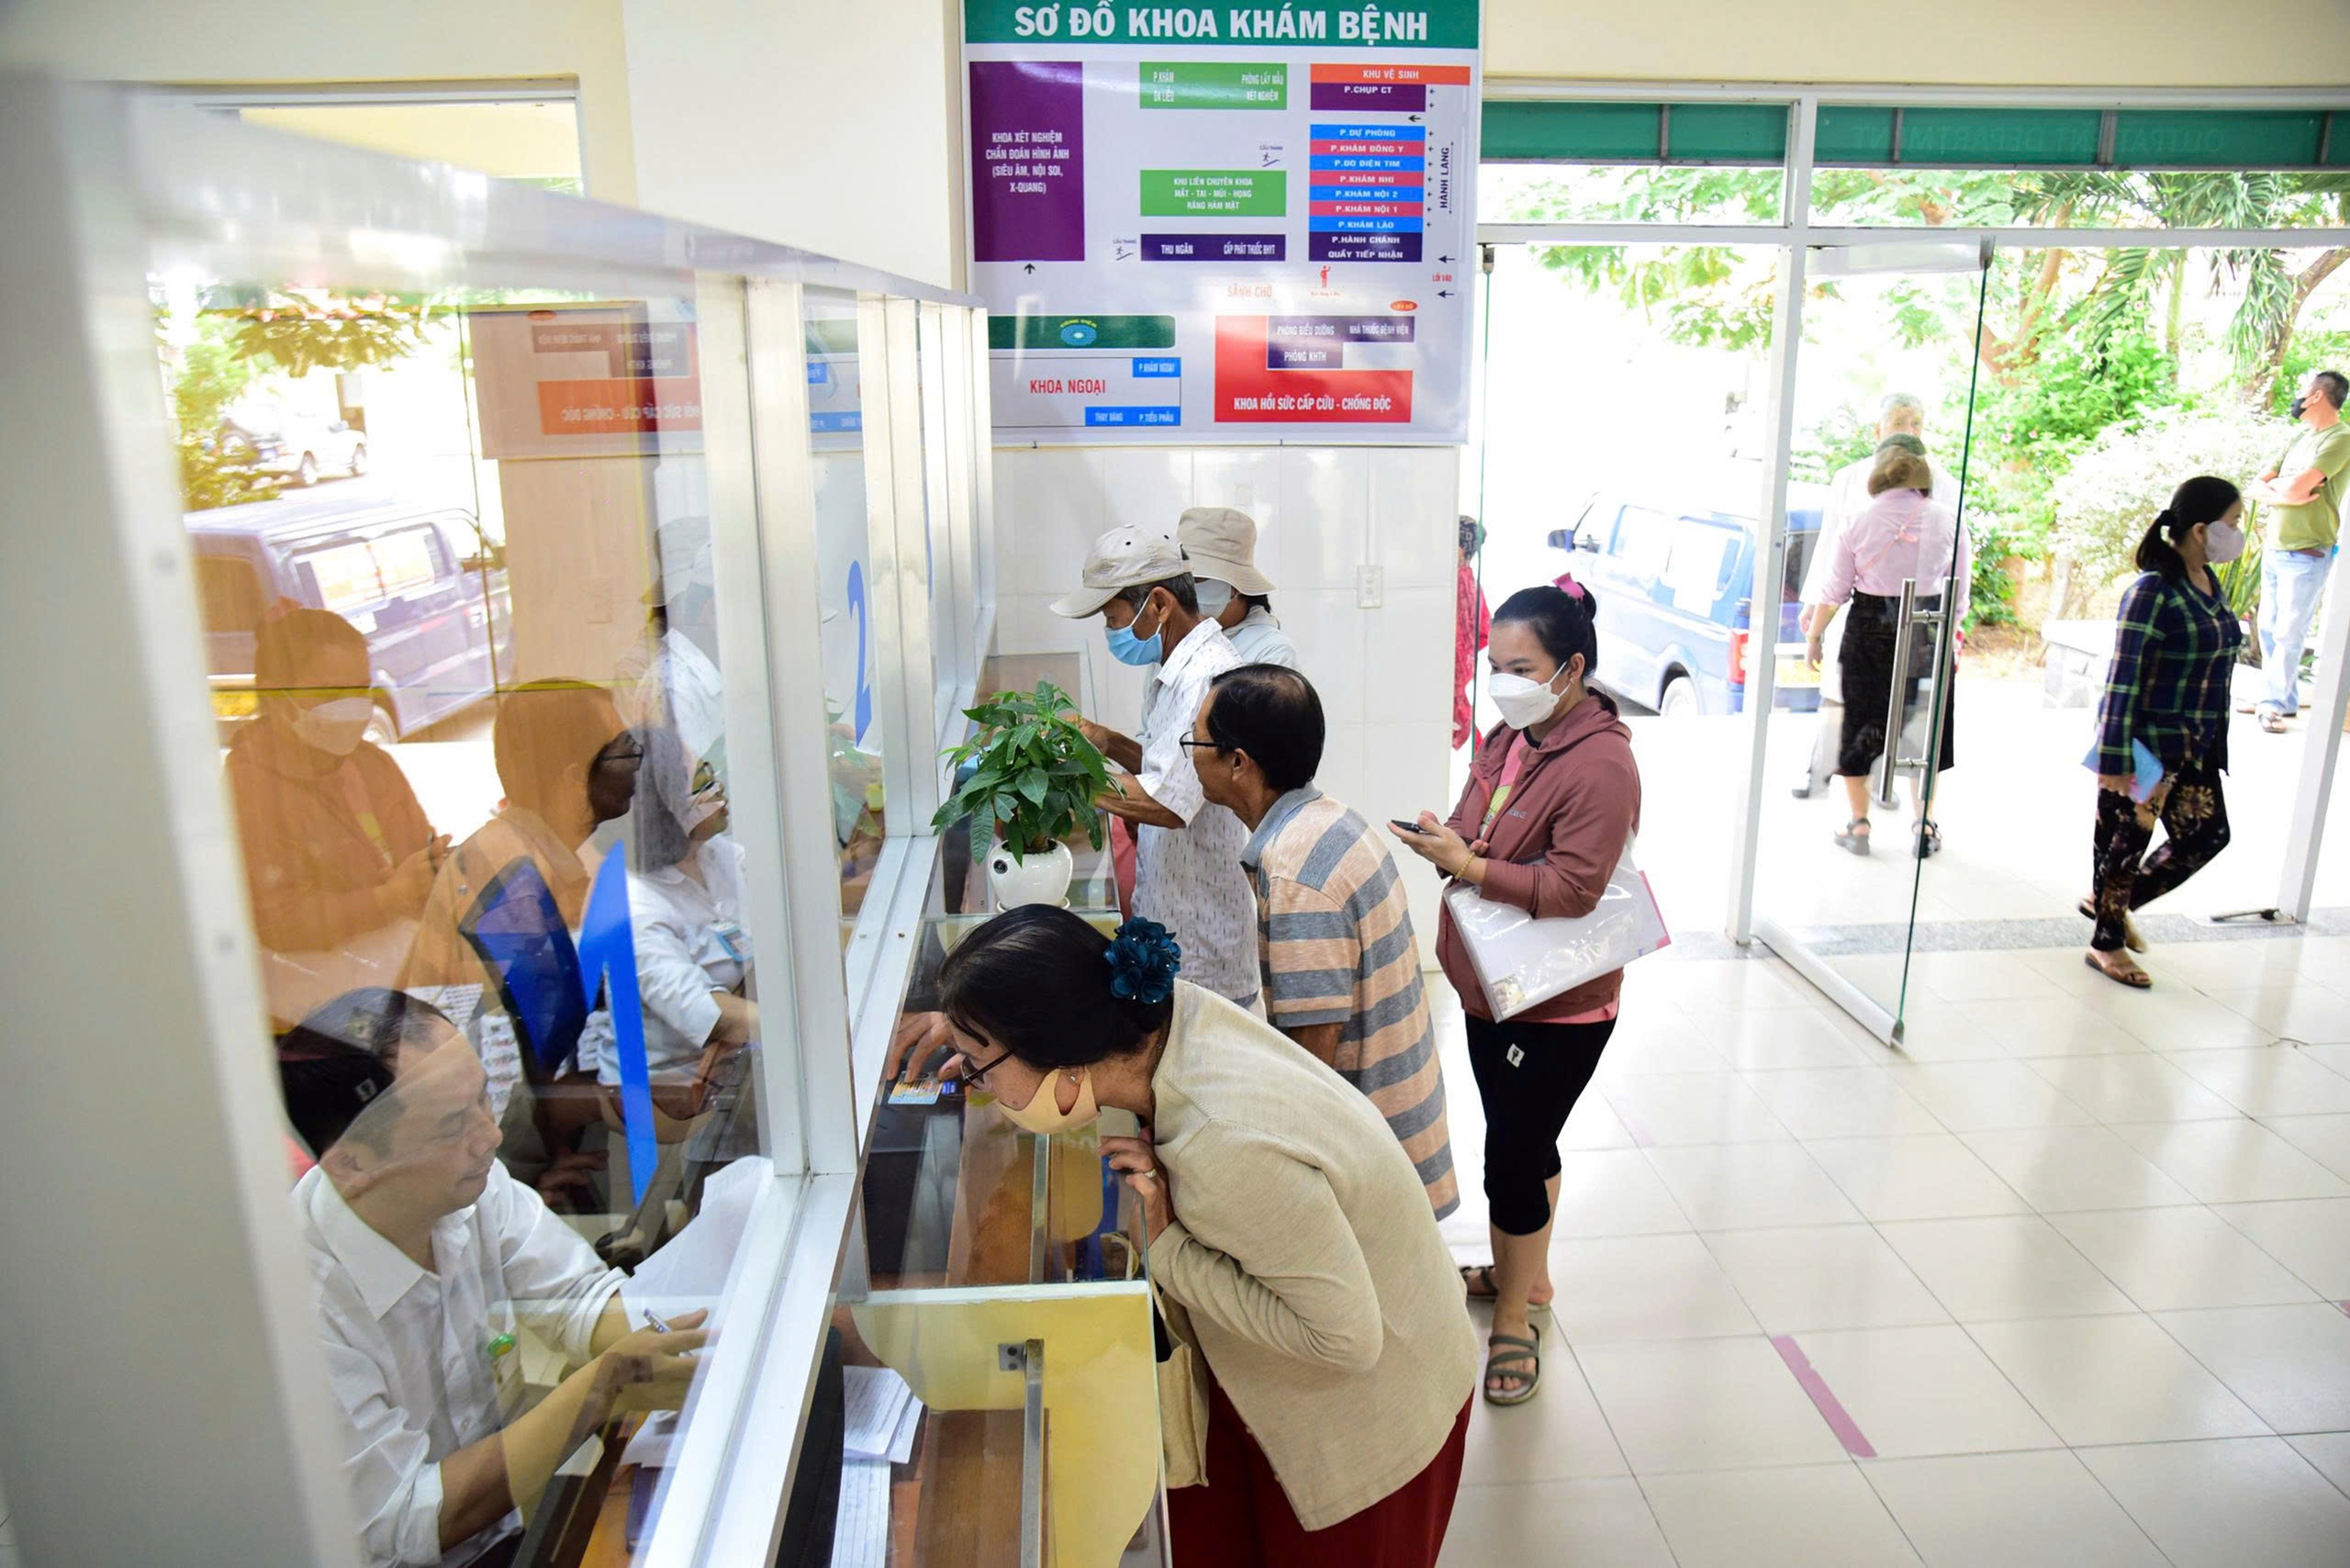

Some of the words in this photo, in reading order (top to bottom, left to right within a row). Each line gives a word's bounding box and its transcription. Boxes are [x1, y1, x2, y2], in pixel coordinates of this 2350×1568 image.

[1014, 3, 1060, 37] SƠ
[1069, 0, 1115, 38] ĐỒ
[1128, 8, 1218, 38] KHOA
[1229, 3, 1326, 39] KHÁM
[1338, 4, 1427, 46] BỆNH
[1362, 70, 1381, 79] KHU
[1383, 67, 1395, 81] VỆ
[1398, 70, 1419, 80] SINH
[992, 132, 1013, 142] KHOA
[1014, 129, 1029, 142] XÉT
[1031, 129, 1062, 144] NGHIỆM
[1365, 128, 1395, 137] PHÒNG
[985, 146, 1007, 160] CHẨN
[1009, 147, 1030, 160] ĐOÁN
[1032, 147, 1051, 160] HÌNH
[1053, 146, 1069, 160] ẢNH
[1384, 160, 1400, 168] TIM
[1440, 147, 1450, 176] LANG
[992, 163, 1013, 177] (SIÊU
[1032, 163, 1046, 179] NỘI
[1173, 177, 1187, 186] KHU
[1189, 175, 1204, 186] LIÊN
[1206, 175, 1233, 186] CHUYÊN
[1235, 177, 1253, 186] KHOA
[1010, 182, 1046, 194] X-QUANG)
[1196, 189, 1206, 197] TAI
[1233, 189, 1252, 199] HỌNG
[1373, 189, 1390, 198] NỘI
[1374, 205, 1390, 214] NỘI
[1161, 244, 1174, 254] THU
[1175, 241, 1193, 254] NGÂN
[1378, 250, 1404, 260] NHẬN
[1030, 379, 1063, 394] KHOA
[1068, 379, 1106, 396] NGOẠI
[1234, 398, 1258, 410] KHOA
[1260, 393, 1275, 410] HỒI
[1277, 395, 1295, 410] SỨC
[1297, 393, 1315, 410] CẤP
[1316, 395, 1334, 410] CỨU
[1342, 394, 1371, 410] CHỐNG
[1373, 395, 1391, 413] ĐỘC
[847, 559, 872, 748] 2
[578, 838, 659, 1210] 1
